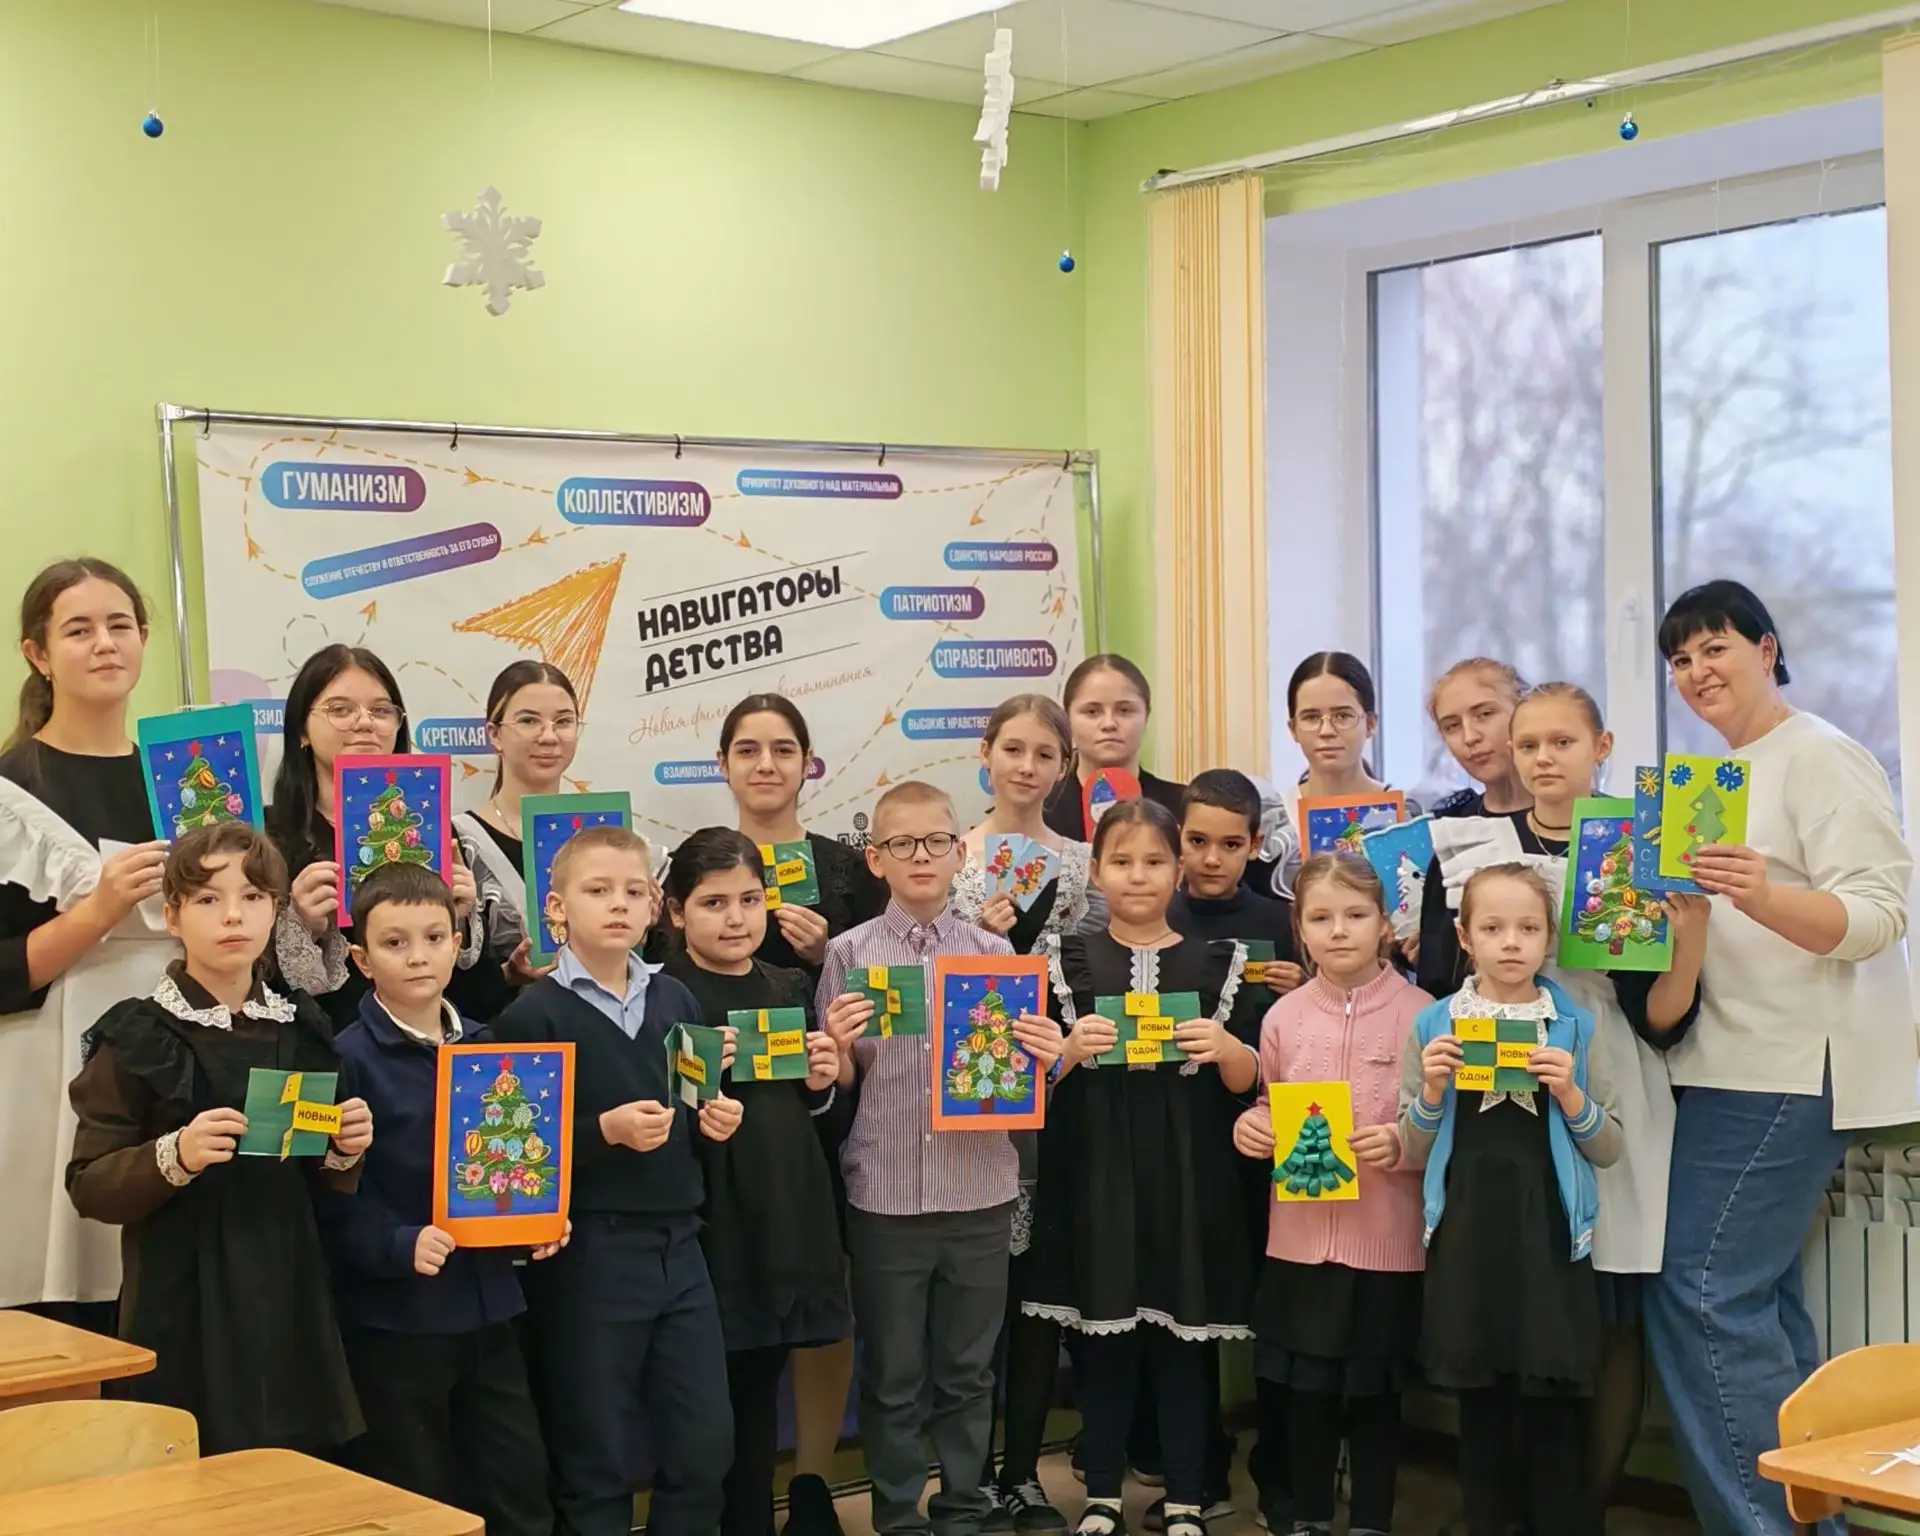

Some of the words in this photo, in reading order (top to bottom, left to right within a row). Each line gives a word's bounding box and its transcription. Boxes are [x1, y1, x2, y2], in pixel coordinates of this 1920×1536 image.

[282, 470, 407, 504] ГУМАНИЗМ
[741, 476, 782, 488] ПРИОРИТЕТ
[782, 478, 824, 490] ДУХОВНОГО
[825, 479, 841, 492] НАД
[841, 480, 899, 493] МАТЕРИАЛЬНЫМ
[564, 487, 705, 517] КОЛЛЕКТИВИЗМ
[343, 561, 381, 579] ОТЕЧЕСТВУ
[388, 545, 450, 568] ОТВЕТСТВЕННОСТЬ
[449, 543, 460, 555] ЗА
[460, 540, 472, 552] ЕГО
[472, 533, 498, 550] СУДЬБУ
[988, 549, 1024, 564] НАРОДОВ
[1024, 550, 1053, 563] РОССИИ
[637, 565, 842, 642] НАВИГАТОРЫ
[892, 594, 973, 613] ПАТРИОТИЗМ
[645, 624, 784, 692] ДЕТСТВА
[934, 647, 1054, 671] СПРАВЕДЛИВОСТЬ
[628, 705, 687, 745] Новая
[907, 717, 947, 731] ВЫСОКИЕ
[421, 726, 487, 747] КРЕПКАЯ
[663, 765, 720, 778] ВЗАИМОУВАЖ
[1140, 1023, 1171, 1032] НОВЫМ
[1472, 1024, 1479, 1033] С
[770, 1037, 800, 1047] НОВЫМ
[297, 1109, 337, 1125] НОВЫМ
